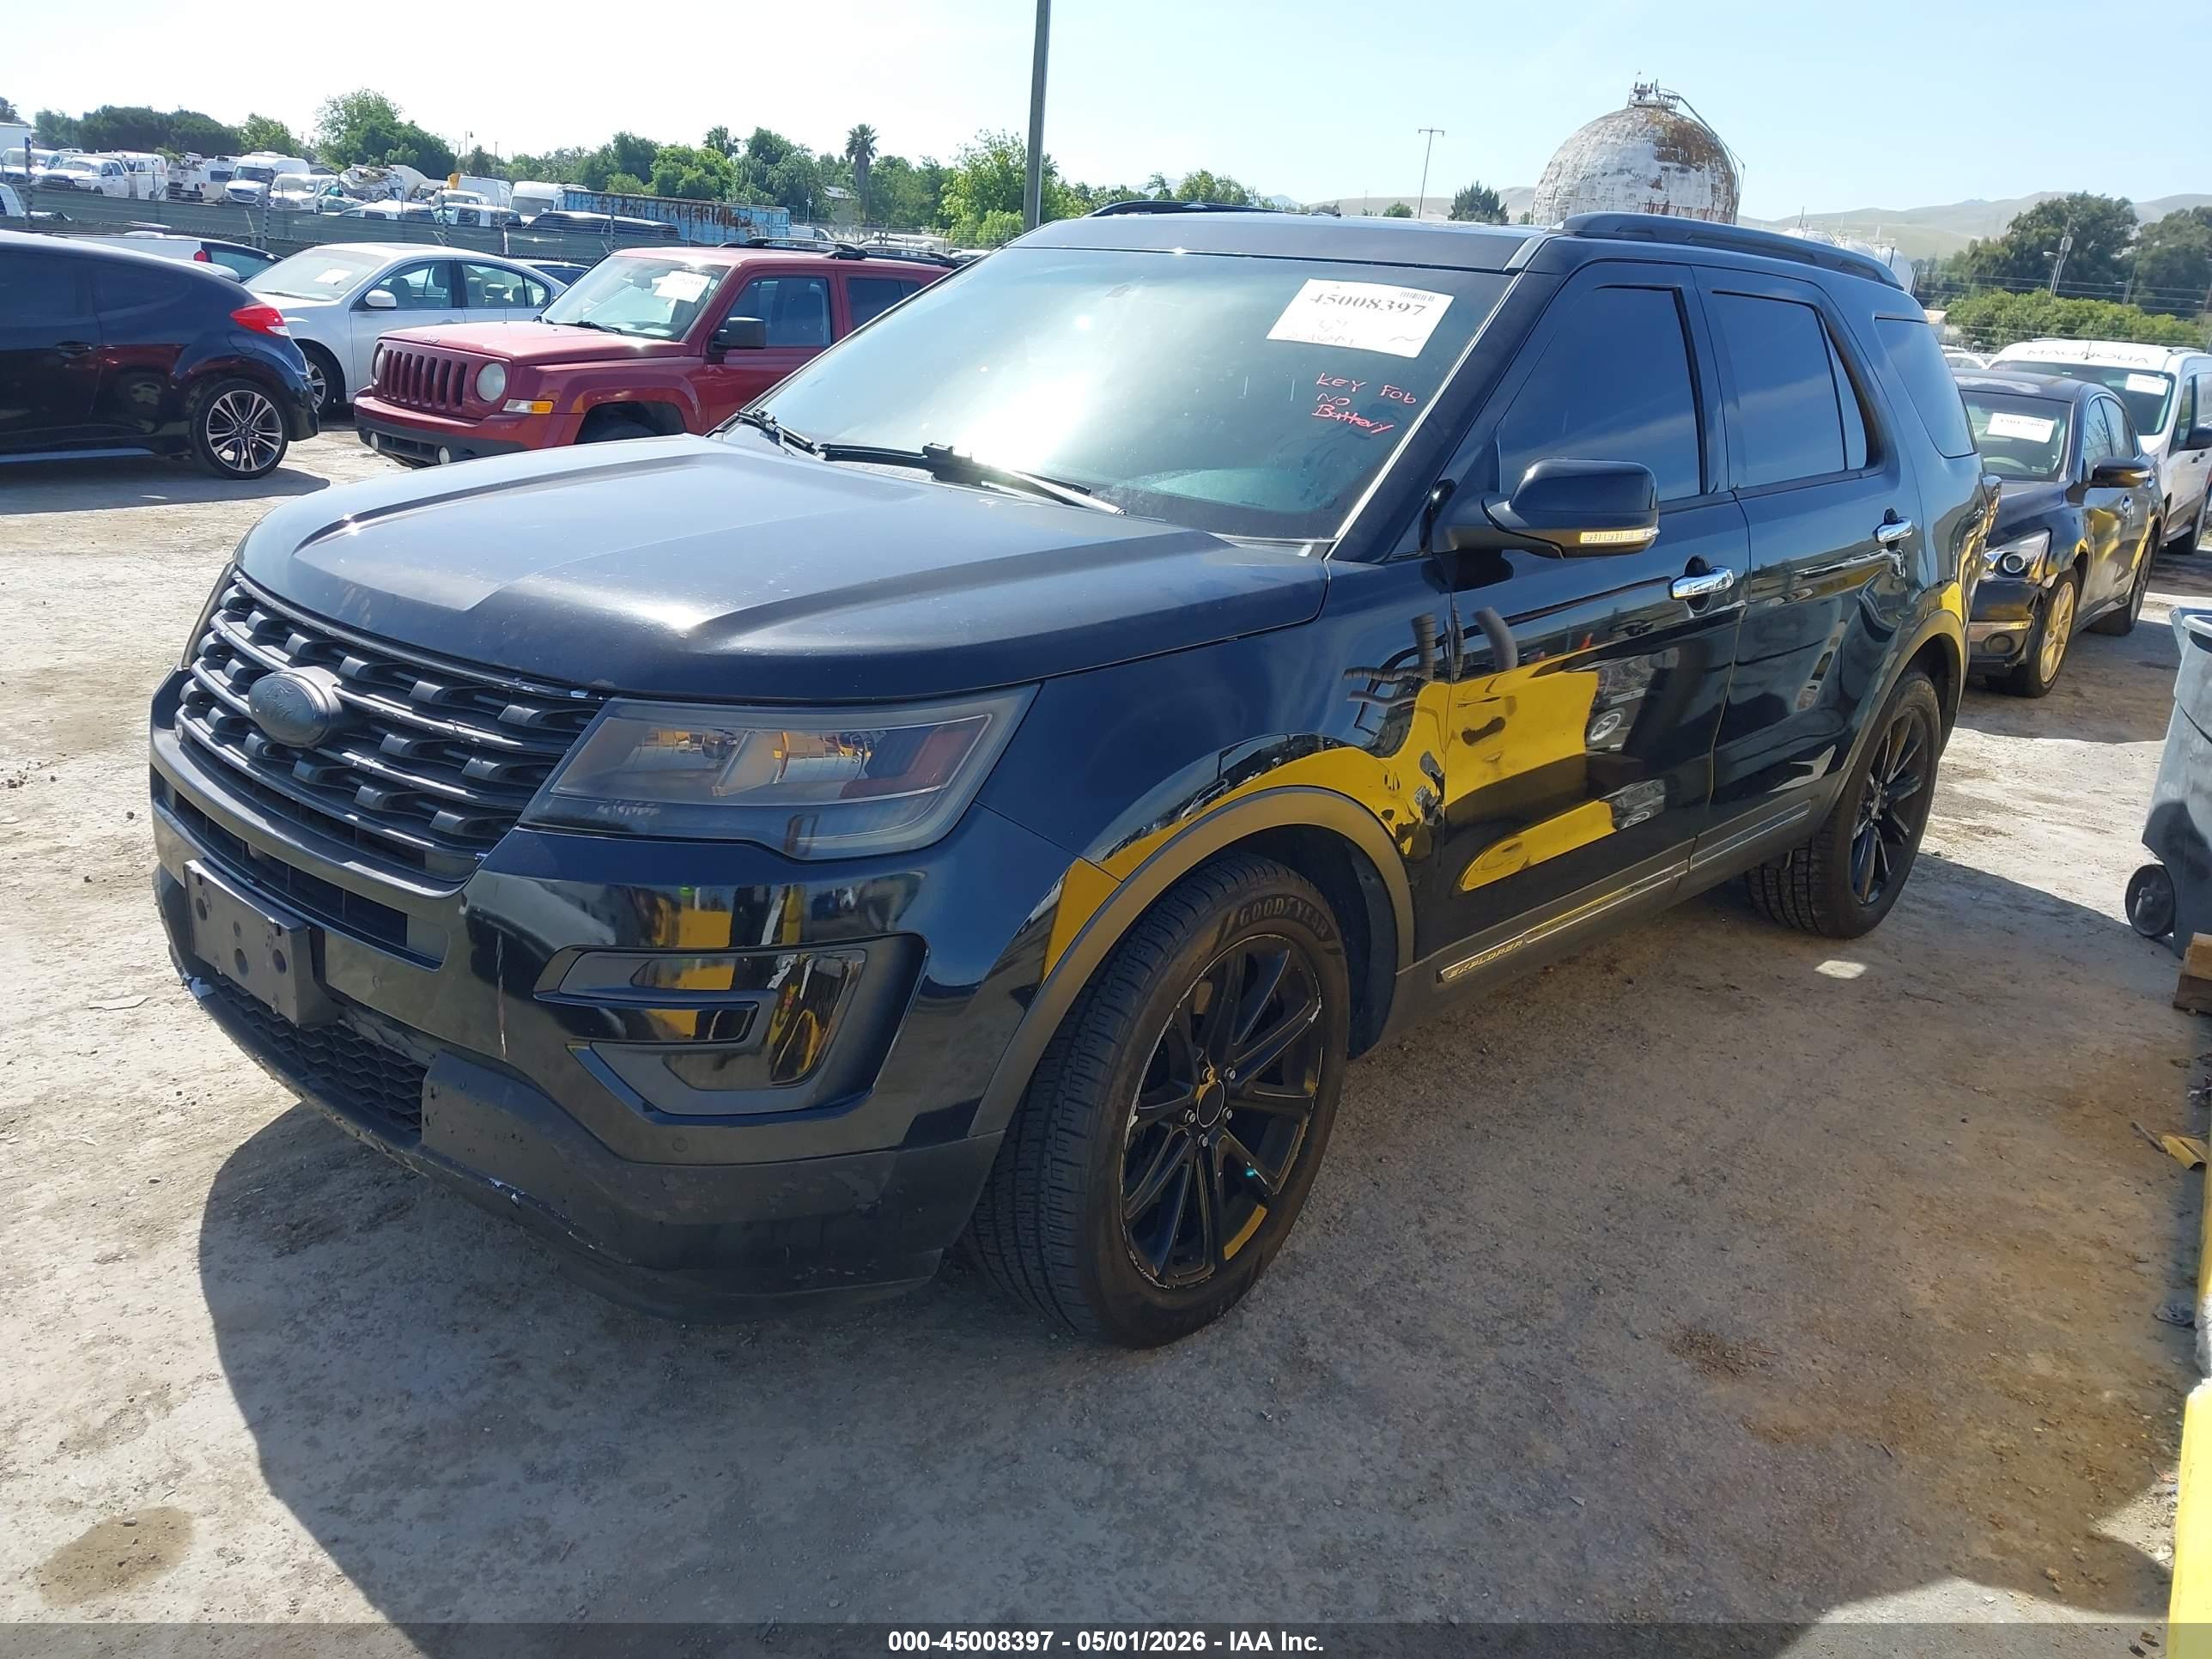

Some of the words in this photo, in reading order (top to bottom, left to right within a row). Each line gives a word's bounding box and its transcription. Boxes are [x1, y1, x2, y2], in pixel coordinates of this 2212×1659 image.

[1310, 293, 1427, 316] 45008397
[2027, 349, 2149, 364] MAGNOLIA
[1316, 372, 1368, 392] KEY
[1316, 392, 1351, 406] NO
[1238, 896, 1329, 939] GOODYEAR
[1447, 939, 1524, 979] EXPLORER
